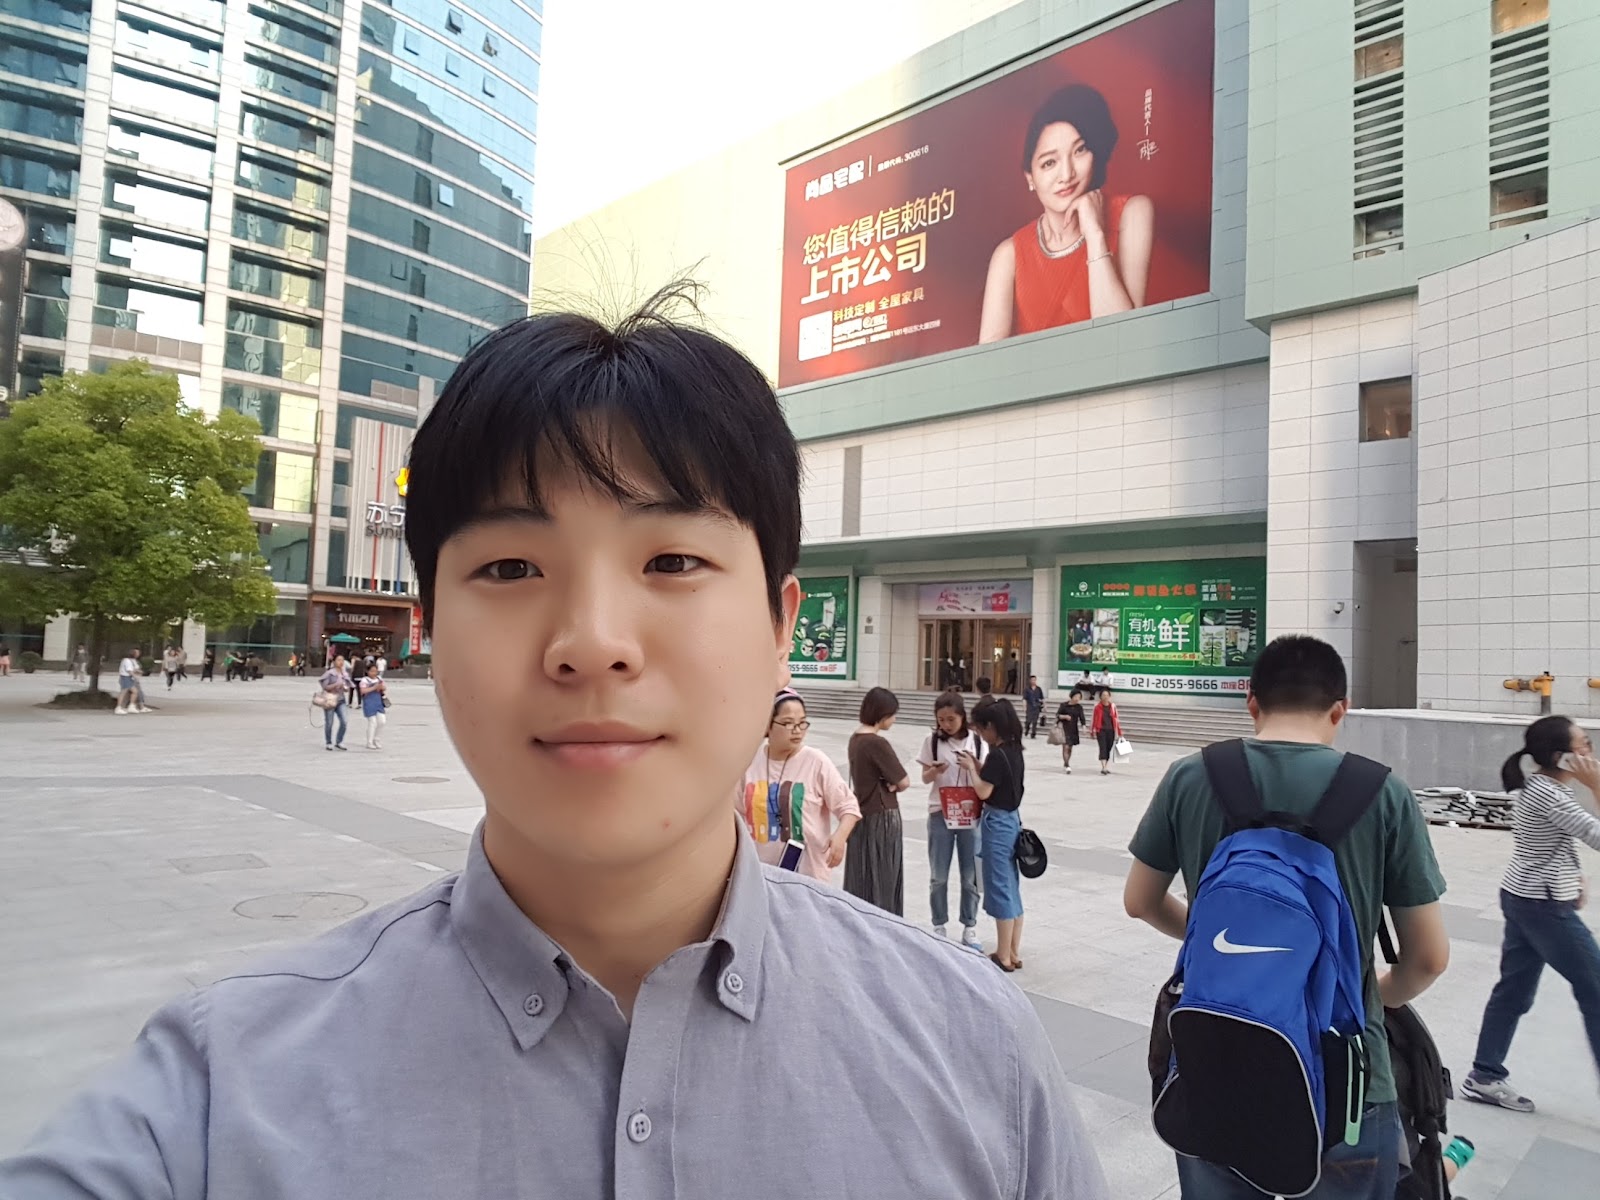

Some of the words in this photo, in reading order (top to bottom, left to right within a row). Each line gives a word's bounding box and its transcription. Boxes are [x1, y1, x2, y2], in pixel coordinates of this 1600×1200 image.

[802, 187, 955, 265] 您值得信赖的
[800, 232, 927, 305] 上市公司
[833, 299, 876, 323] 科技定制
[366, 500, 406, 527] 苏宁
[1128, 617, 1157, 633] 有机
[1157, 617, 1191, 651] 鲜
[1127, 633, 1157, 648] 蔬菜
[1131, 677, 1218, 691] 021-2055-9666
